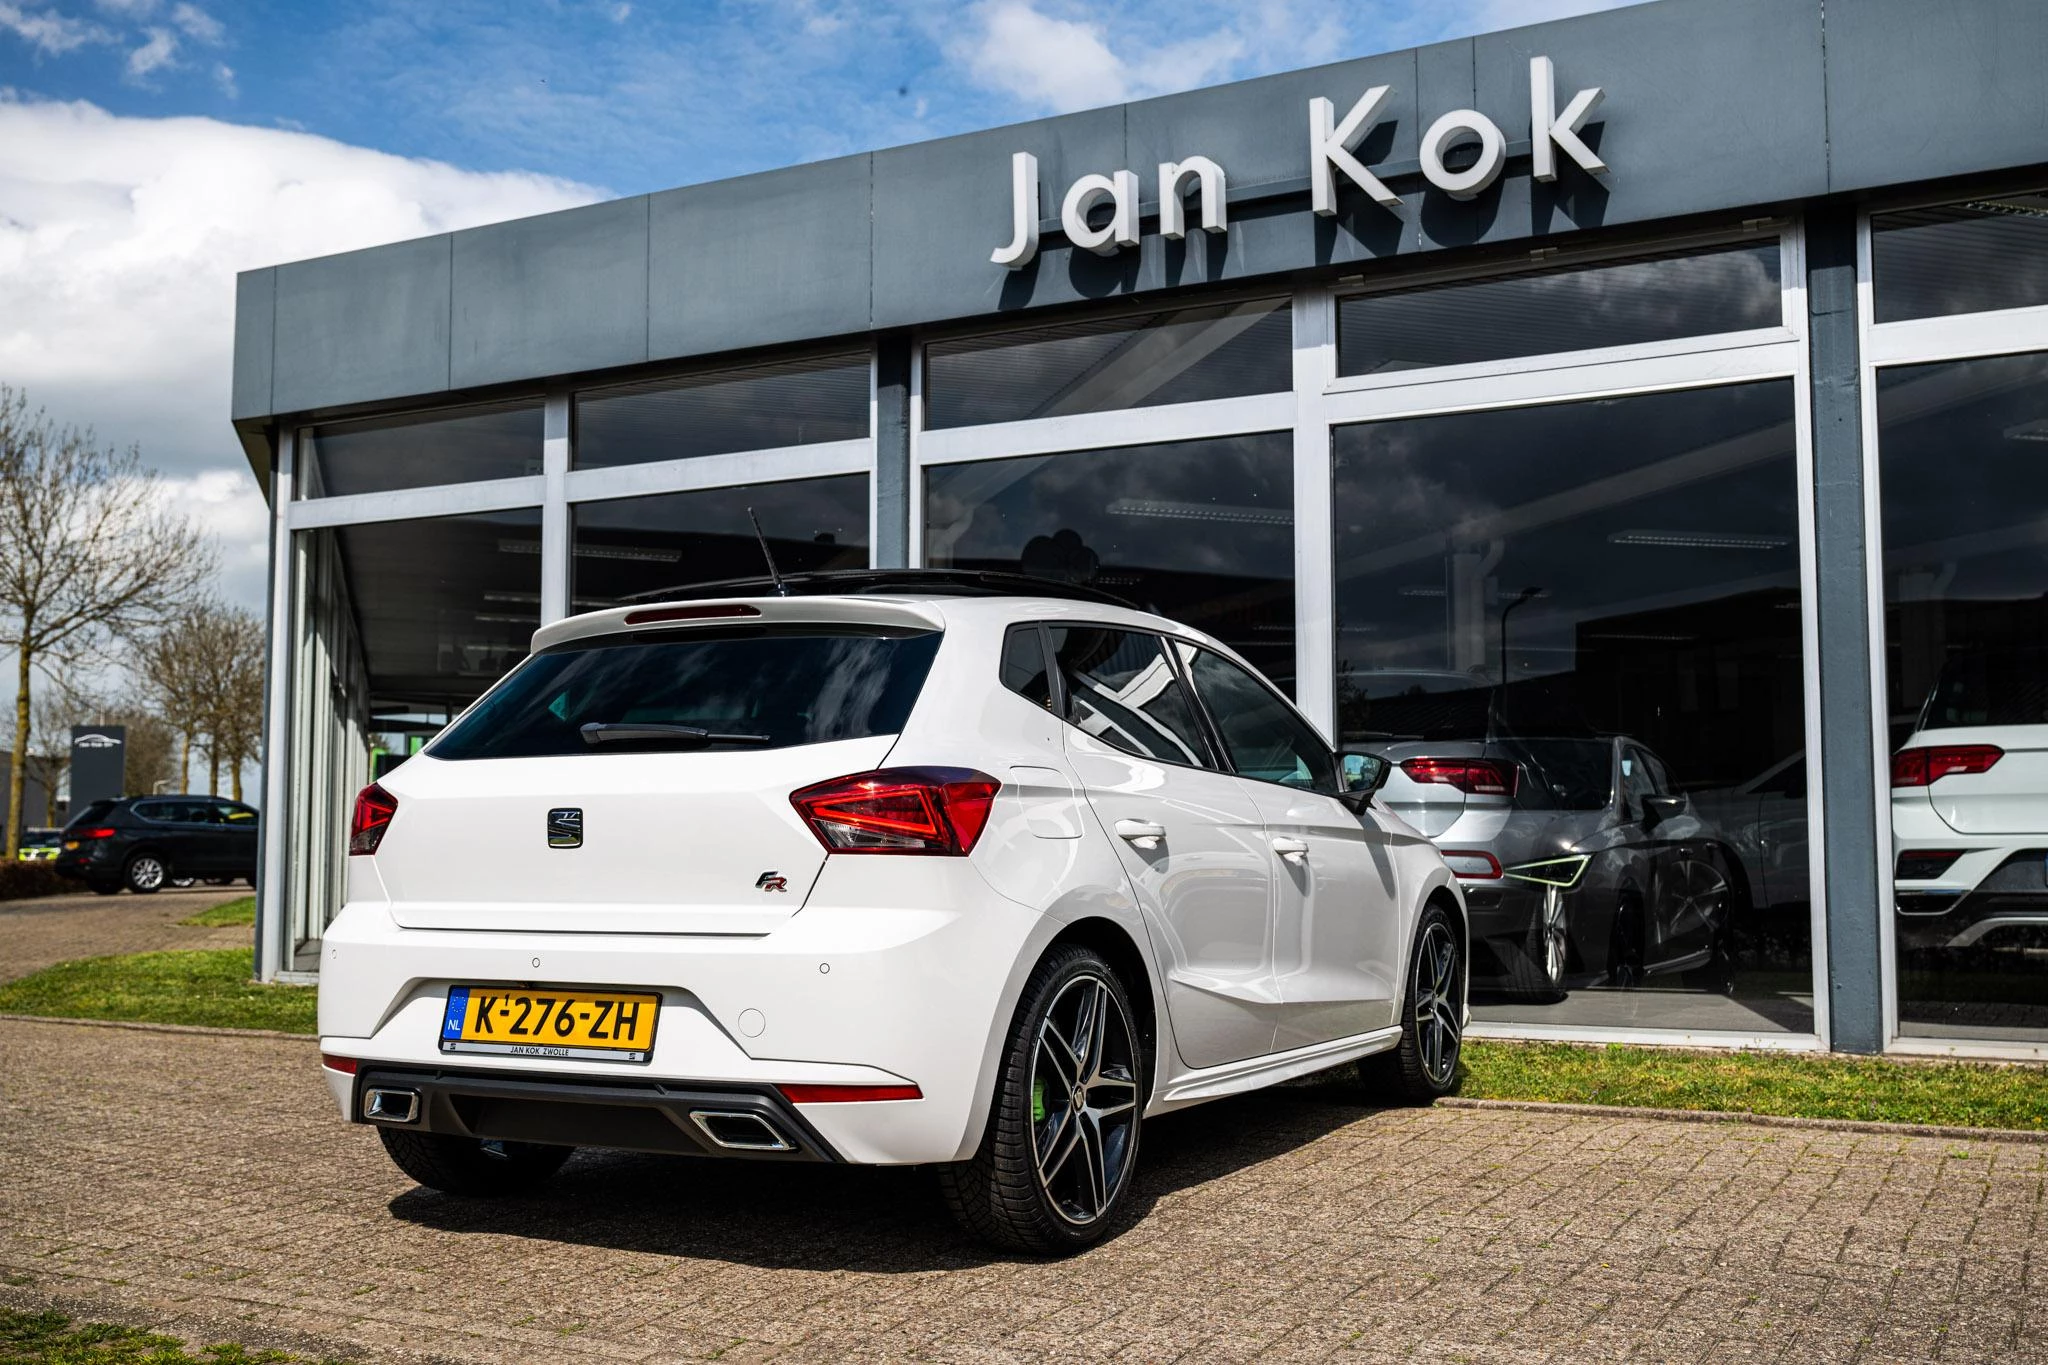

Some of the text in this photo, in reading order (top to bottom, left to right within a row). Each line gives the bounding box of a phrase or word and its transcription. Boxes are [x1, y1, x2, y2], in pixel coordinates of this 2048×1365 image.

[990, 55, 1611, 271] Jan Kok
[755, 870, 788, 893] FR
[447, 1019, 461, 1032] NL
[474, 995, 641, 1042] K-276-ZH
[510, 1046, 569, 1057] JAN KOK ZWOLLE
